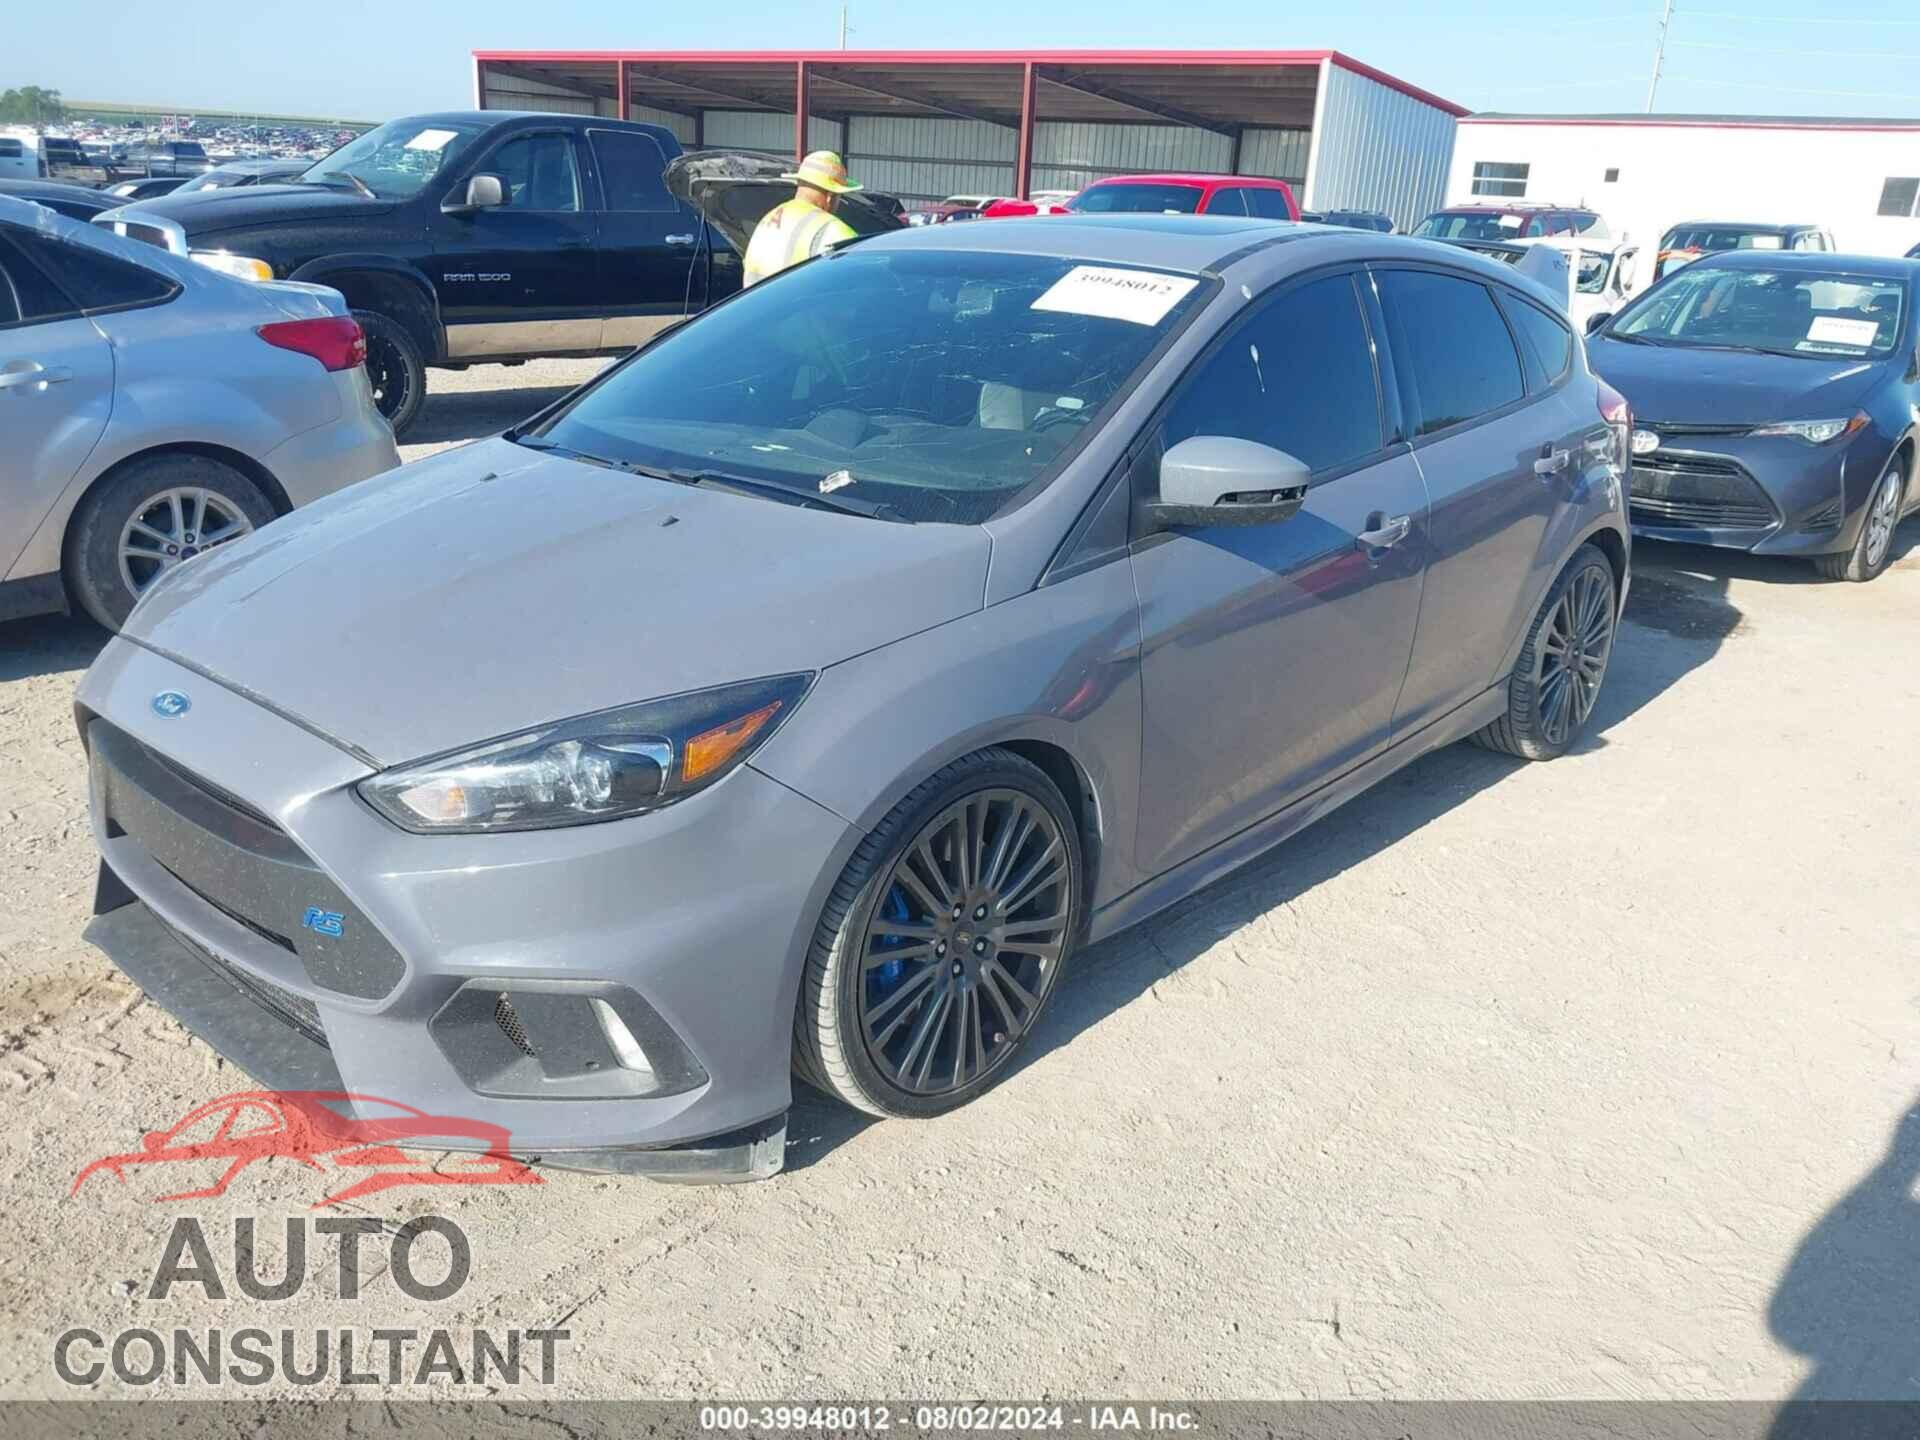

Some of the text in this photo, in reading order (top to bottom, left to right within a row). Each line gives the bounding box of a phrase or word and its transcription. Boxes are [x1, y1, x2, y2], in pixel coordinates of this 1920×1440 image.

[443, 273, 512, 282] RAM 1500
[303, 905, 345, 938] RS
